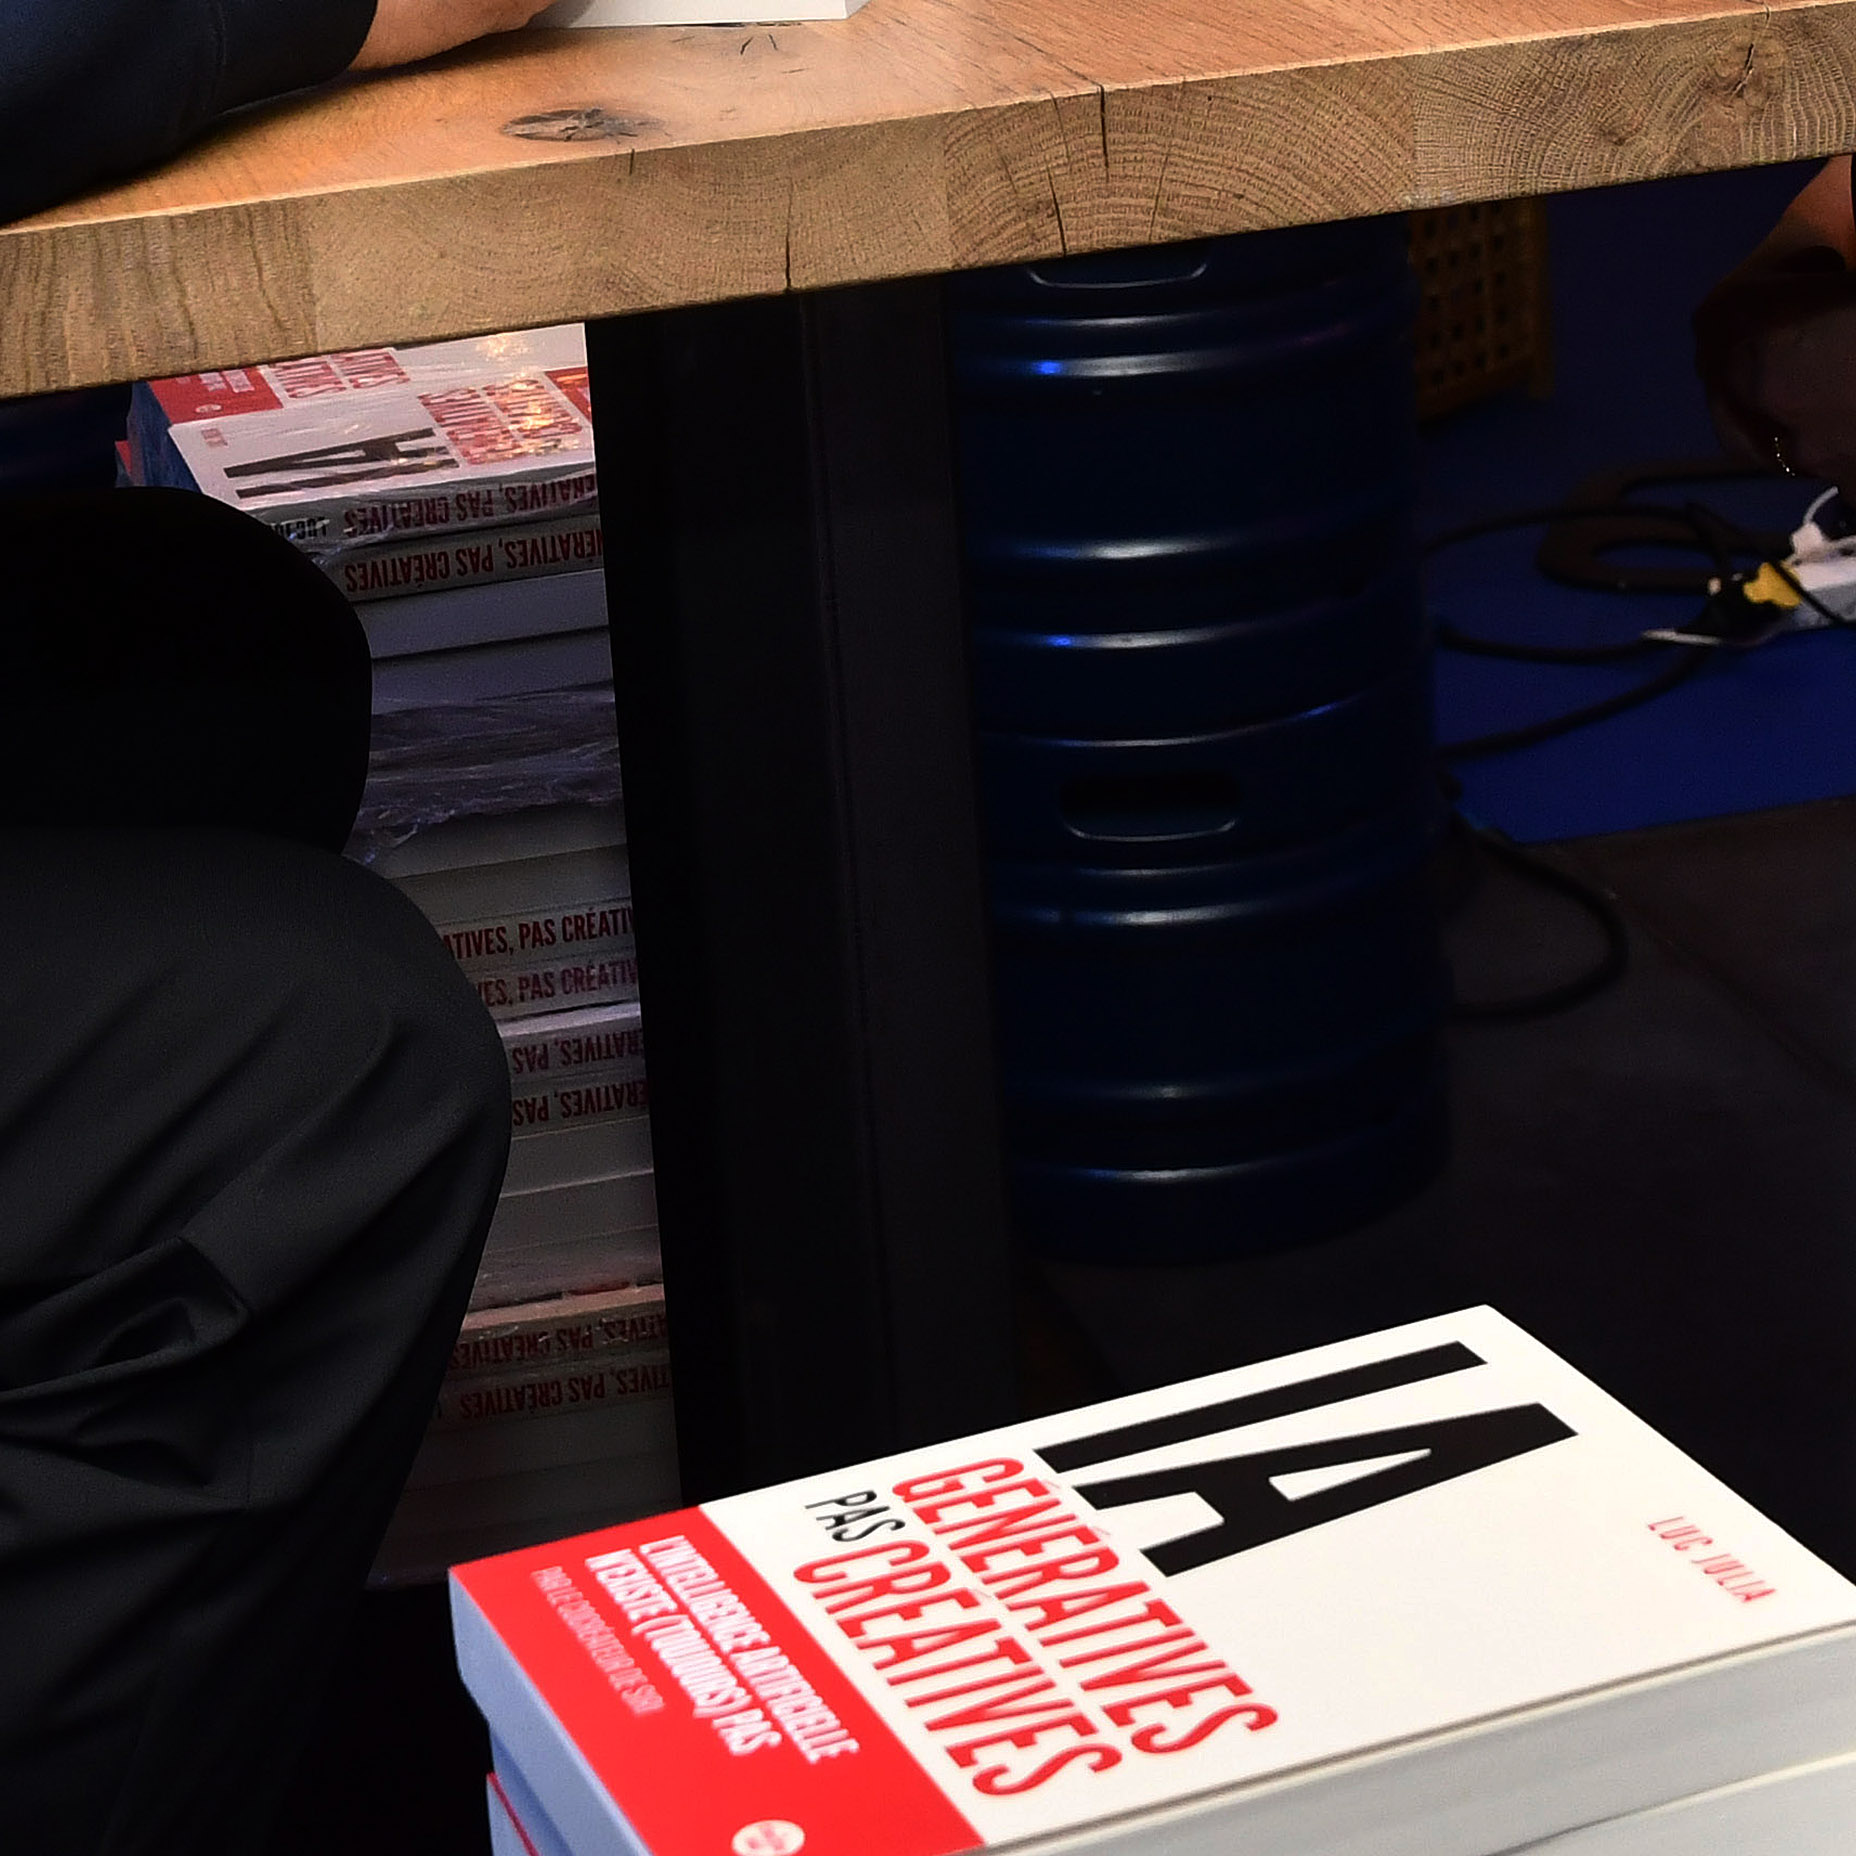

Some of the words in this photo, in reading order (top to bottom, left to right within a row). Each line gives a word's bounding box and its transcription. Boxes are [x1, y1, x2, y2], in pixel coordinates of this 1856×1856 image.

[223, 427, 460, 499] IA
[457, 489, 494, 521] PAS
[345, 549, 450, 592] CRÉATIVES
[456, 547, 494, 576] PAS
[519, 918, 556, 949] PAS
[519, 970, 555, 1002] PAS
[512, 1044, 549, 1074] PAS
[513, 1096, 549, 1126] PAS
[557, 1325, 592, 1353] PAS
[460, 1379, 561, 1419] CRÉATIVES
[568, 1373, 604, 1403] PAS
[1033, 1340, 1579, 1578] IA
[804, 1490, 906, 1543] PAS
[1647, 1515, 1715, 1554] LUC
[1691, 1548, 1778, 1605] JULIA
[891, 1456, 1279, 1754] GÉNÉRATIVES
[631, 1614, 753, 1719] (TOUJOURS)
[712, 1708, 783, 1756] PAS
[793, 1539, 1123, 1796] CRÉATIVES
[730, 1646, 860, 1764] ARTIFICIELLE
